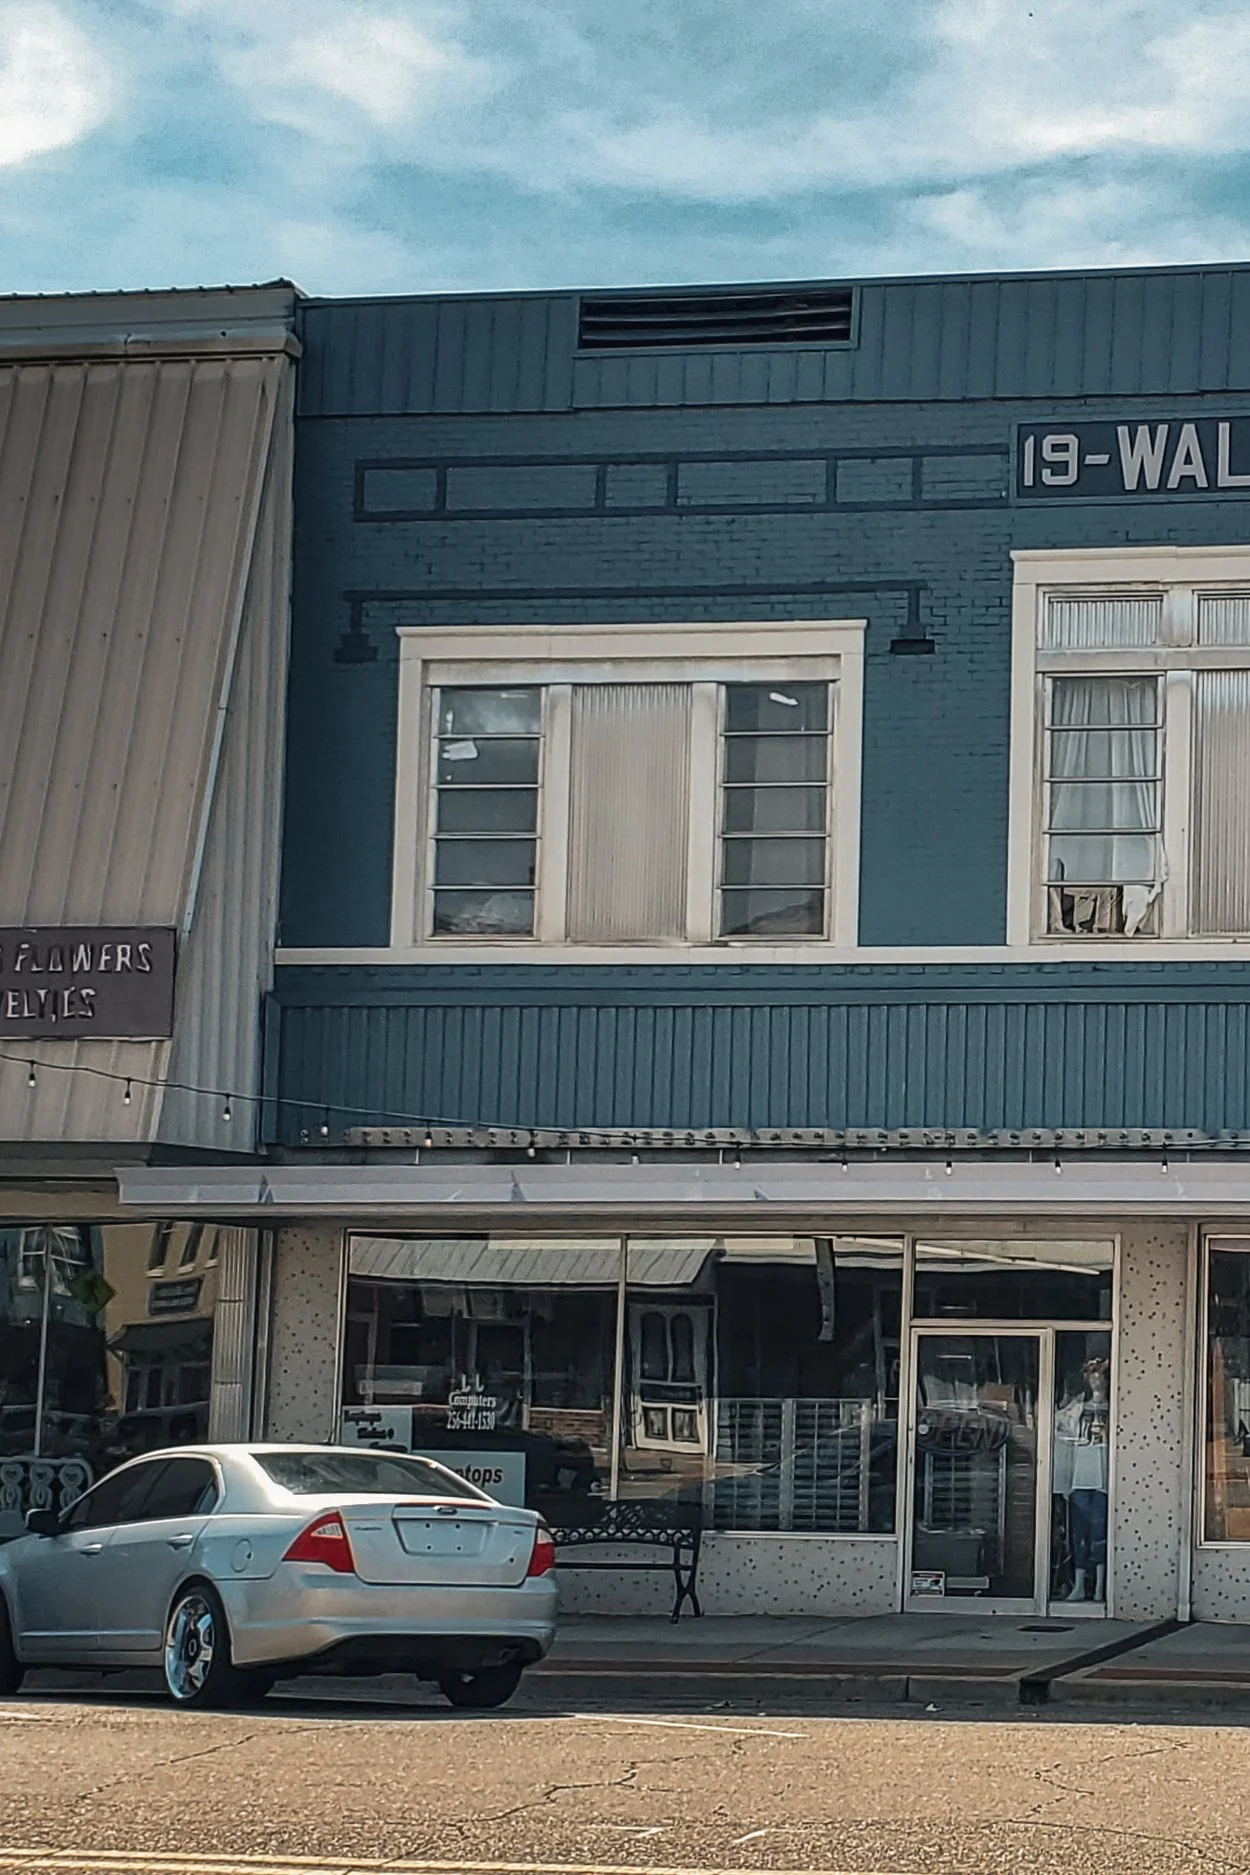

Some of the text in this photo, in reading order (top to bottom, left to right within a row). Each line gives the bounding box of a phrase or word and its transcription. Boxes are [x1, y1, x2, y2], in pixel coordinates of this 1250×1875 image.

[14, 943, 152, 973] FLOWERS
[0, 986, 97, 1022] ELTIES
[449, 1390, 497, 1410] Computers
